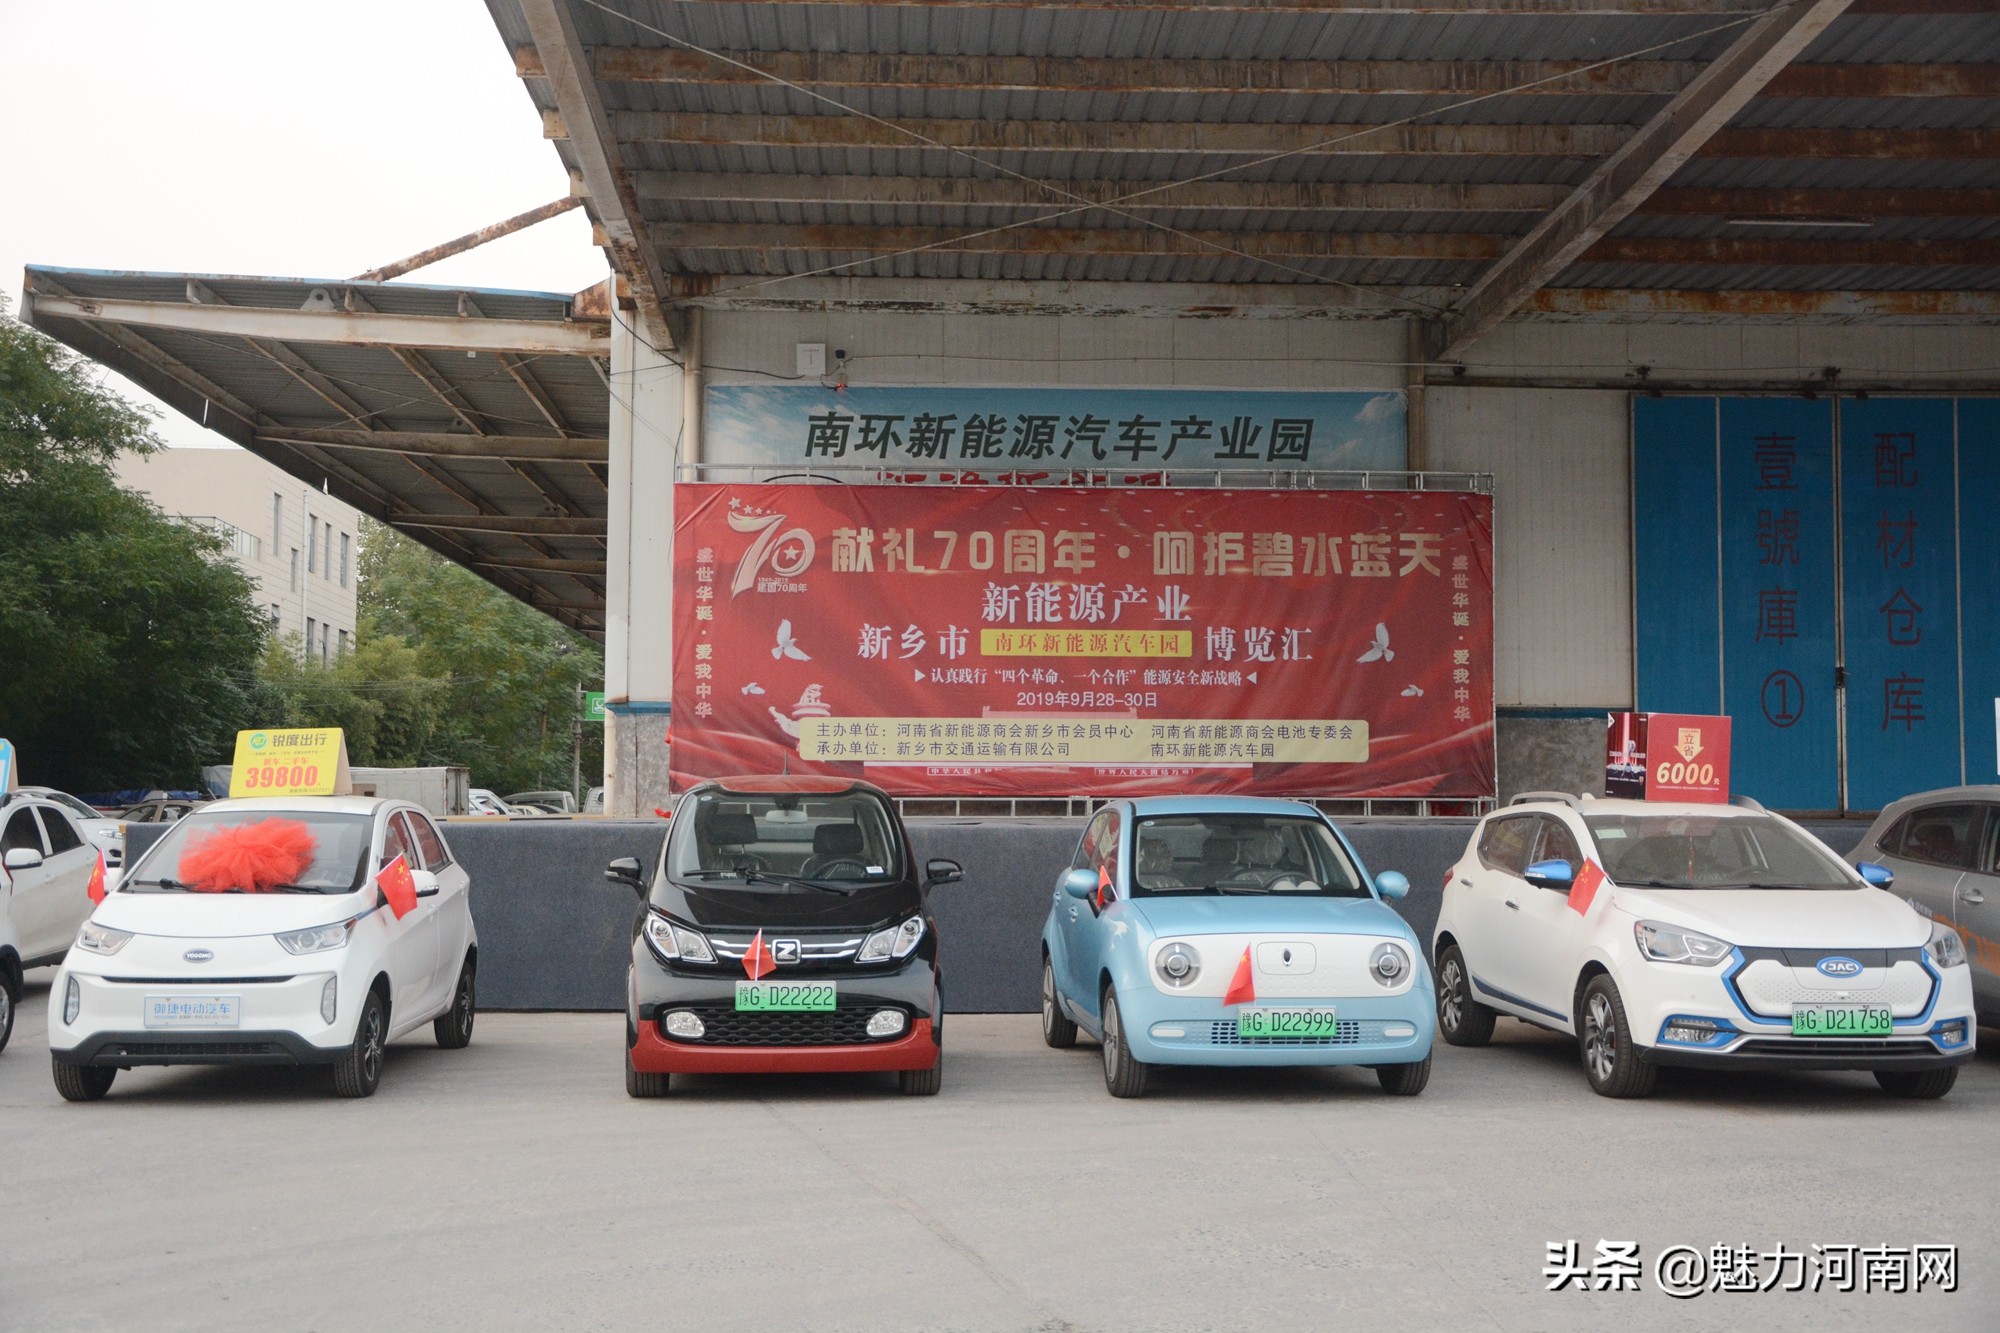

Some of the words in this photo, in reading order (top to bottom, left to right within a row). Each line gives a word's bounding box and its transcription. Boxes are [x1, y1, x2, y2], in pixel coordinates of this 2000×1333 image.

[805, 411, 1314, 462] 南环新能源汽车产业园
[1873, 432, 1925, 732] 配材仓库
[981, 582, 1192, 623] 新能源产业
[857, 623, 970, 660] 新乡市
[995, 632, 1180, 654] 南环新能源汽车园
[1204, 626, 1313, 662] 博览汇
[1151, 725, 1353, 740] 河南省新能源商会电池专委会
[1151, 743, 1275, 757] 南环新能源汽车园
[245, 765, 318, 788] 39800
[1828, 960, 1857, 973] JAC
[154, 1003, 231, 1014] 御捷电动汽车
